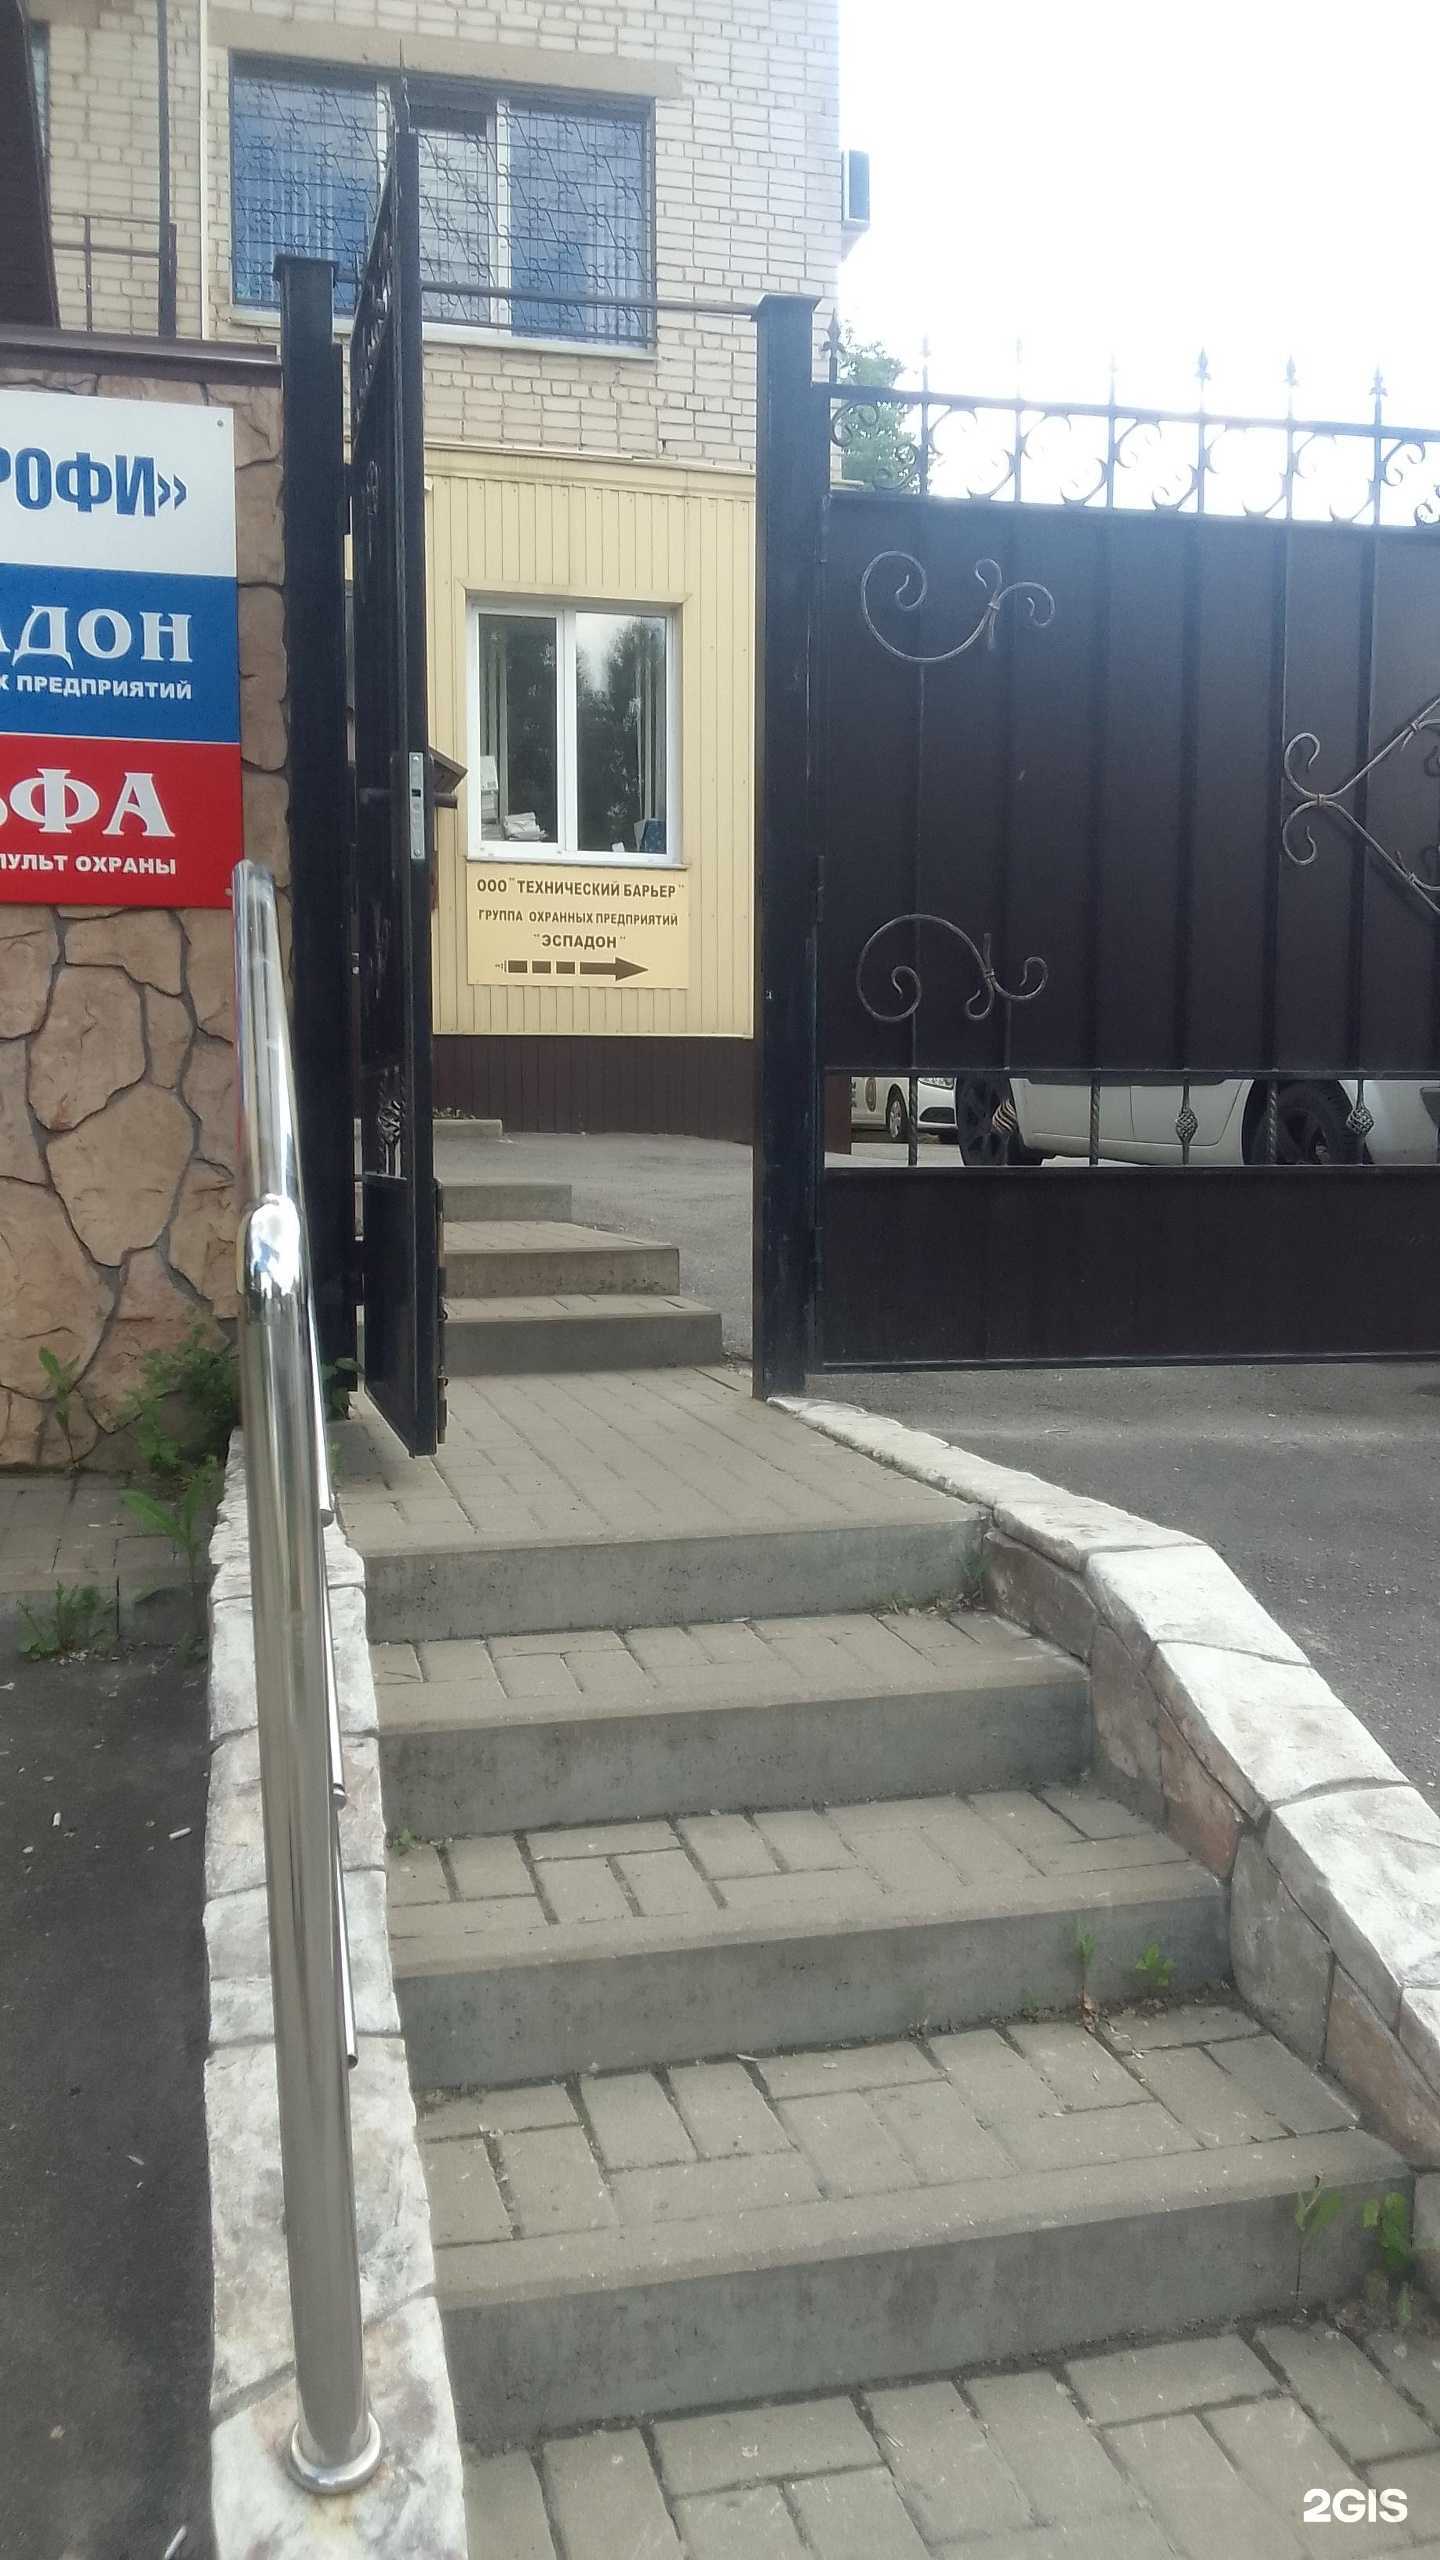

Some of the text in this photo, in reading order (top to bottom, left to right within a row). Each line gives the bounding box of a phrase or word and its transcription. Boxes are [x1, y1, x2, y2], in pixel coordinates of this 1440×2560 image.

[0, 605, 192, 671] ДОН
[17, 675, 192, 700] ПРЕДПРИЯТИЙ
[0, 768, 176, 838] ФА
[75, 855, 176, 875] ОХРАНЫ
[477, 879, 507, 893] ООО
[478, 909, 678, 926] ГРУППА ОХРАННЫХ ПРЕДПРИЯТИЙ
